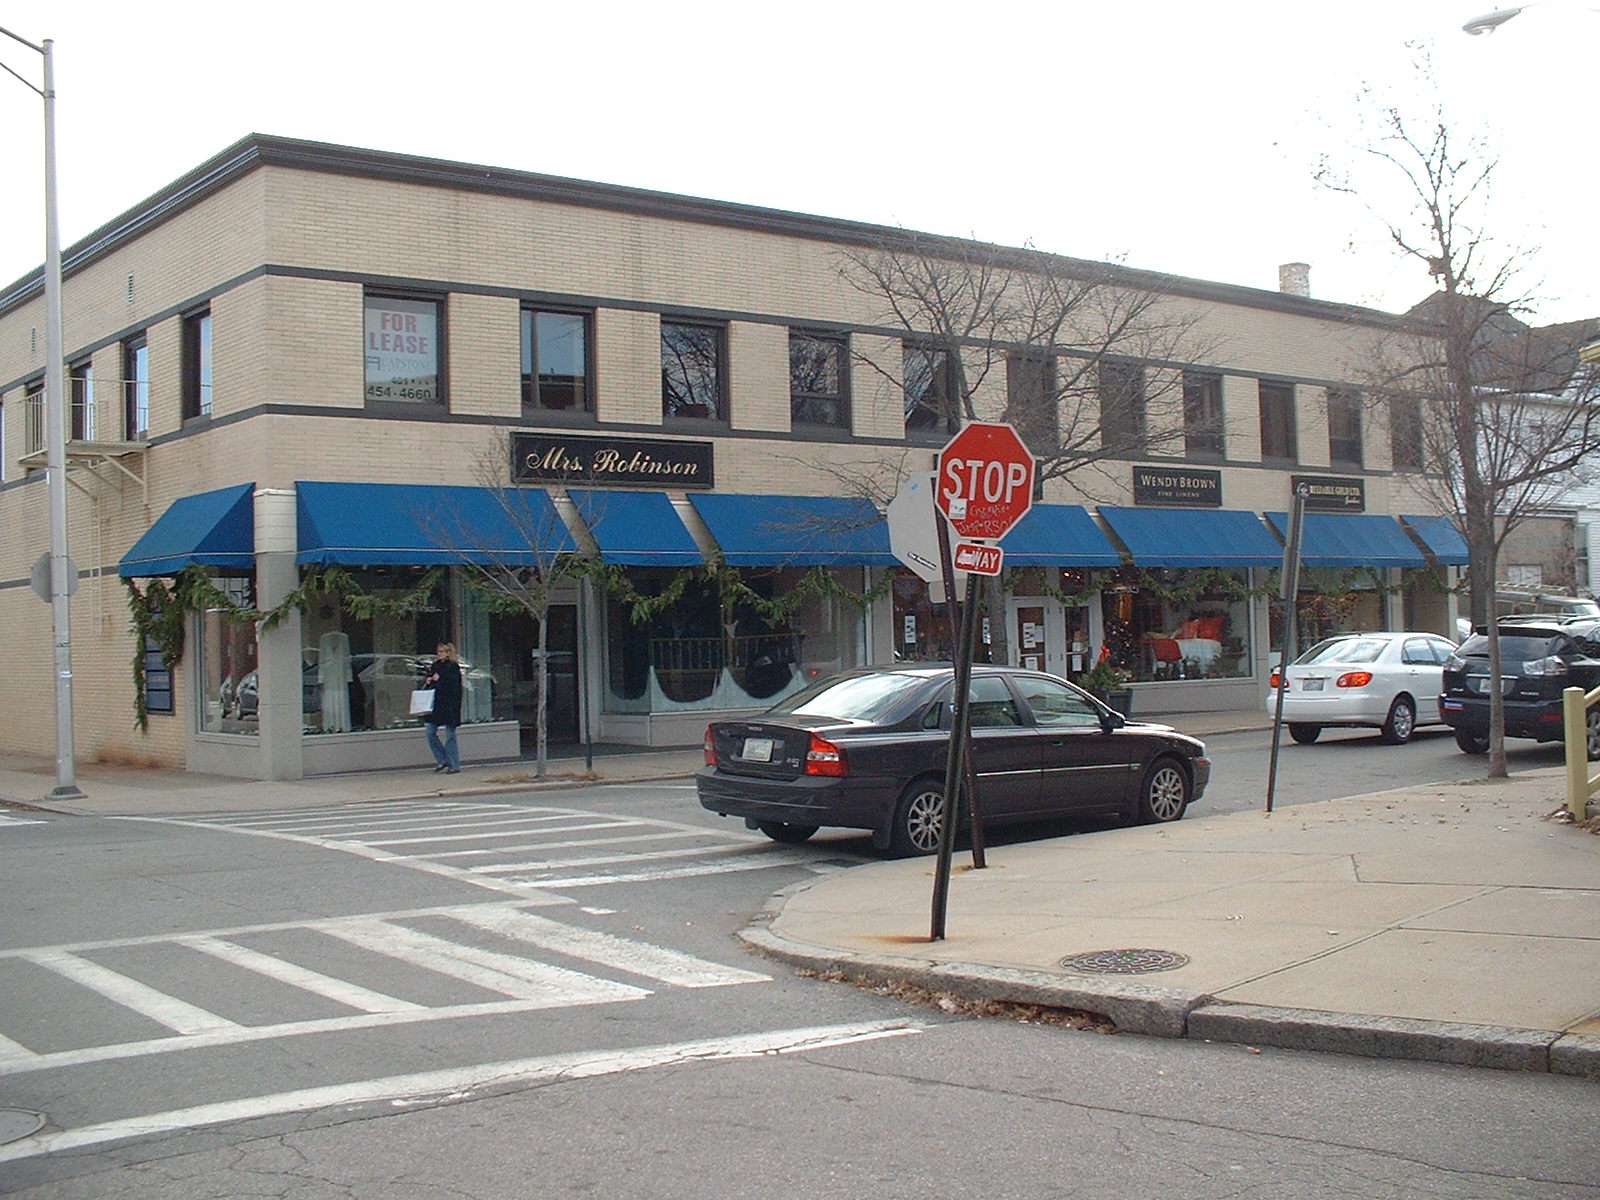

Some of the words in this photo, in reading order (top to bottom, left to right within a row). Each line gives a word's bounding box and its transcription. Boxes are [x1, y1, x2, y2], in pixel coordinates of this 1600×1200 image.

[381, 313, 417, 333] FOR
[369, 332, 428, 354] LEASE
[382, 358, 432, 369] CAPSTONE
[526, 446, 583, 471] Mrs.
[592, 448, 699, 475] Robinson
[943, 458, 1027, 504] STOP
[1141, 475, 1179, 487] WENDY
[1180, 477, 1216, 488] BROWN
